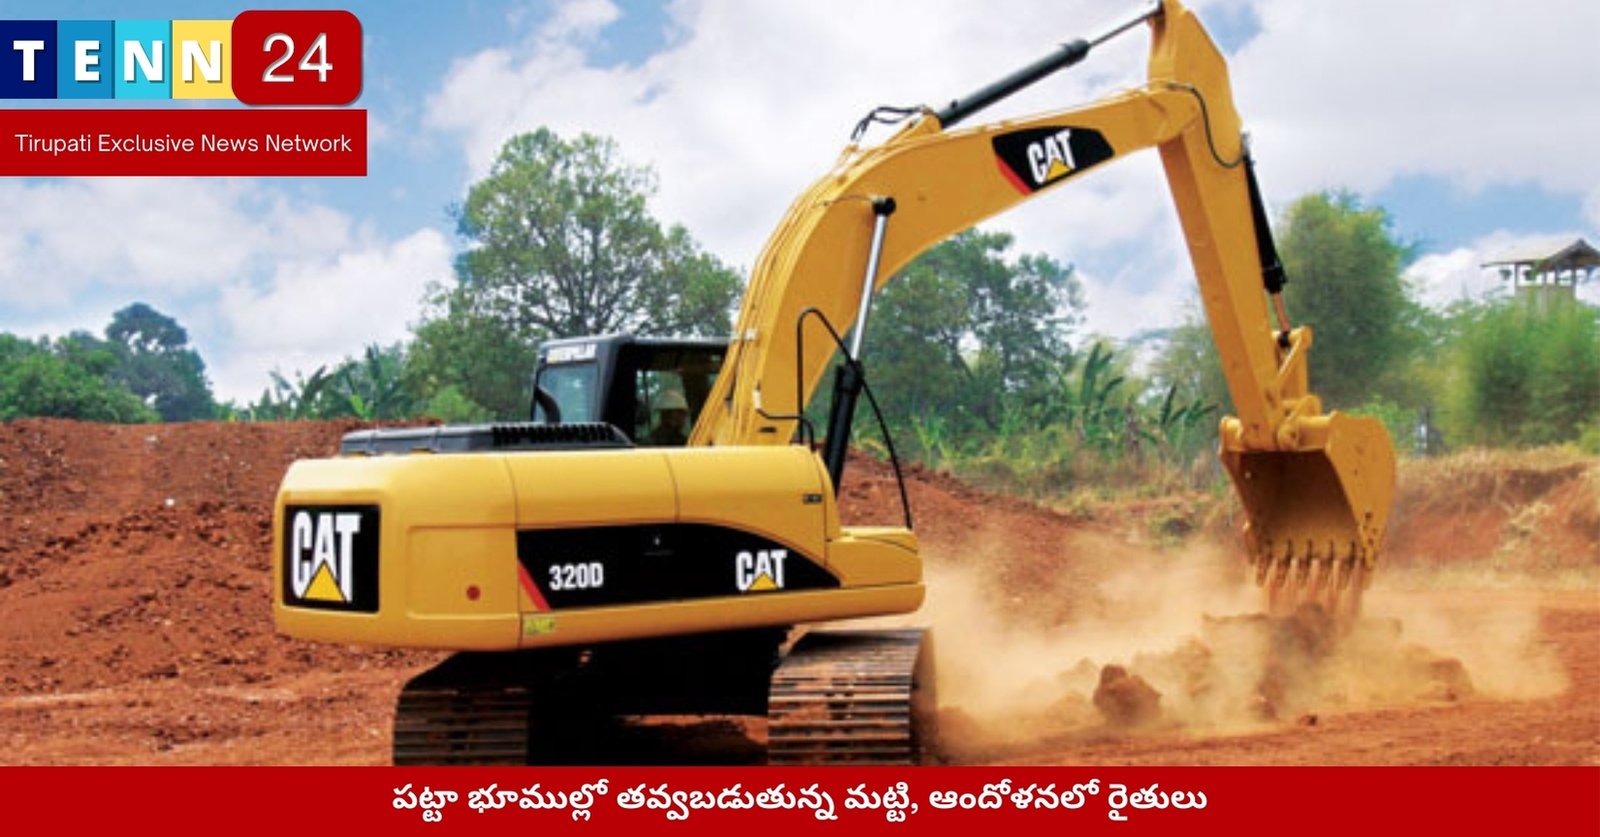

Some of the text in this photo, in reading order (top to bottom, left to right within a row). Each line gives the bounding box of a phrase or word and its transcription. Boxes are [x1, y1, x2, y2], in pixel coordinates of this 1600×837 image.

[1027, 128, 1076, 185] CAT
[292, 511, 362, 603] CAT
[549, 562, 604, 591] 320D
[735, 549, 788, 592] CAT
